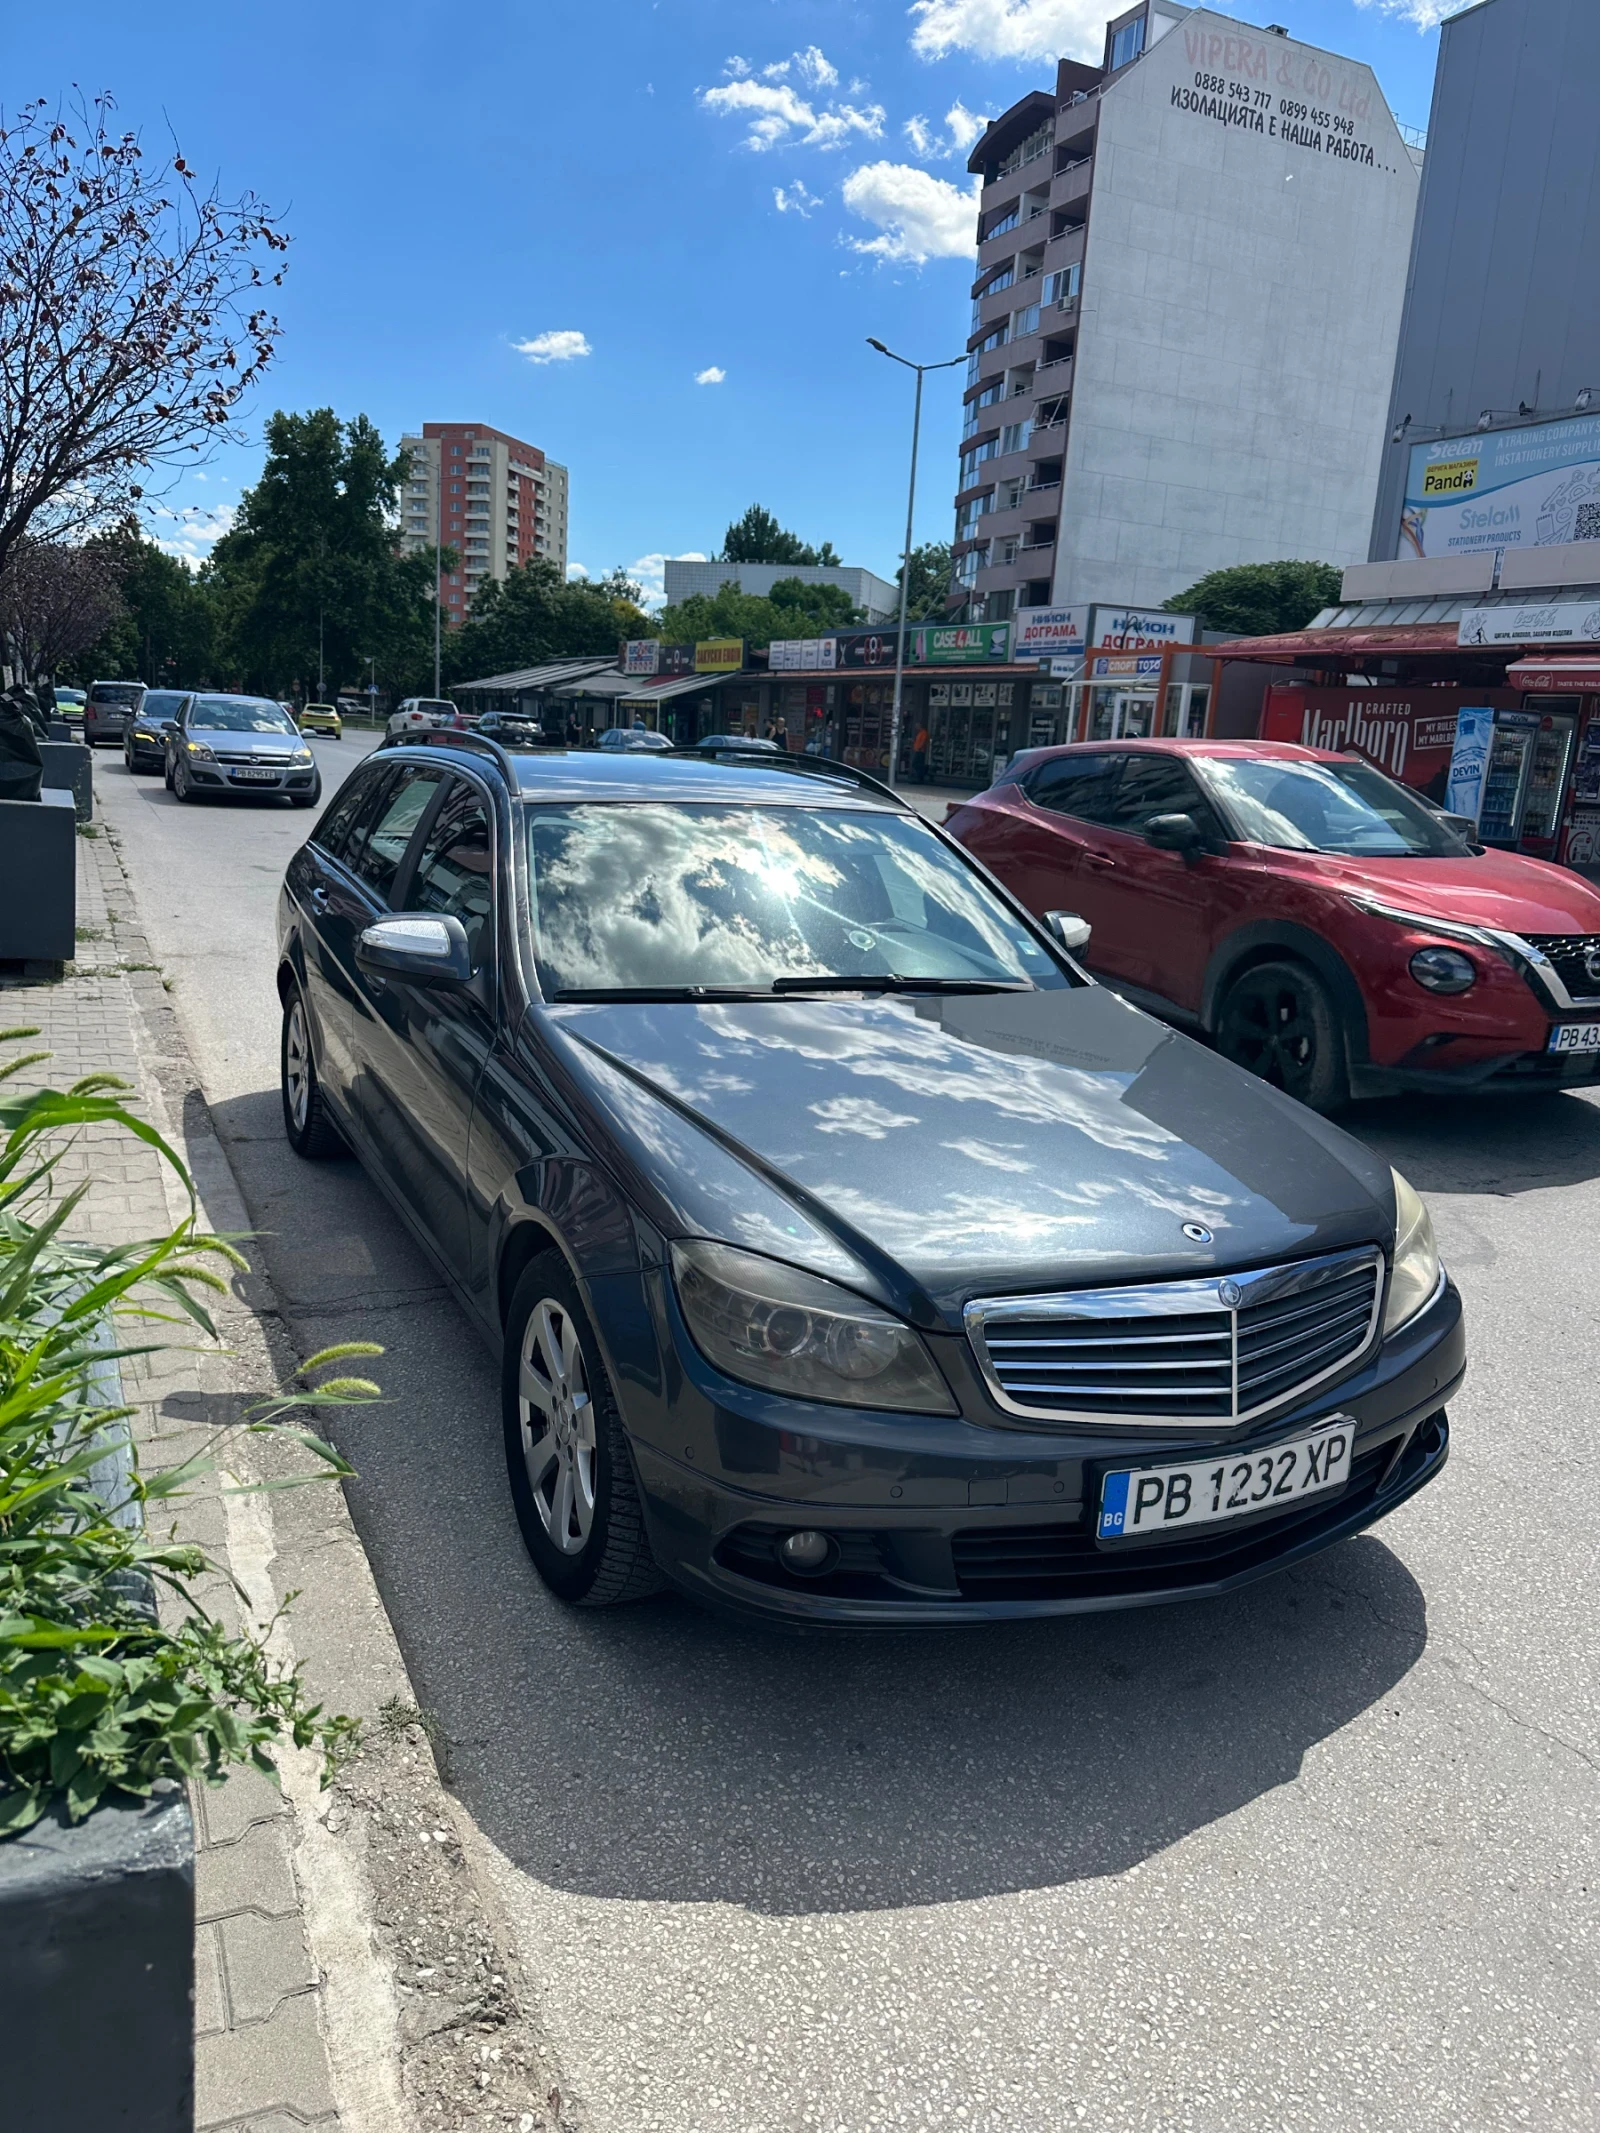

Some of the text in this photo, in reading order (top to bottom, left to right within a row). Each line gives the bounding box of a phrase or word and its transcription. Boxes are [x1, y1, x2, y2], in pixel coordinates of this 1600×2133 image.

[1184, 29, 1267, 81] VIPERA
[1276, 50, 1295, 89] &
[1303, 63, 1331, 101] CO
[1195, 71, 1355, 136] 0888 543 717 0899 455 948
[1171, 85, 1264, 133] ИЗОЛАЦИЯТА
[1269, 115, 1277, 136] Е
[1281, 120, 1321, 152] НАША
[1496, 436, 1503, 450] A
[1504, 430, 1545, 448] TRADING
[1546, 422, 1595, 441] COMPANY
[1427, 460, 1478, 473] ВЕРИГА МАГАЗИНИ
[1448, 530, 1521, 547] STATIONERY PRODUCTS
[1024, 624, 1077, 641] ДОГРАМА
[1109, 659, 1161, 671] СПОРТ ТОТО
[1366, 703, 1411, 715] CRAFTED
[1426, 721, 1457, 733] MY RULES
[1510, 714, 1528, 723] DEVIN
[1301, 702, 1409, 777] Marlboro
[1418, 735, 1429, 745] MY
[1453, 764, 1479, 777] DEVIN
[1559, 1028, 1579, 1049] PB
[1133, 1434, 1346, 1525] PB 1232 XP
[1103, 1512, 1123, 1528] BG
